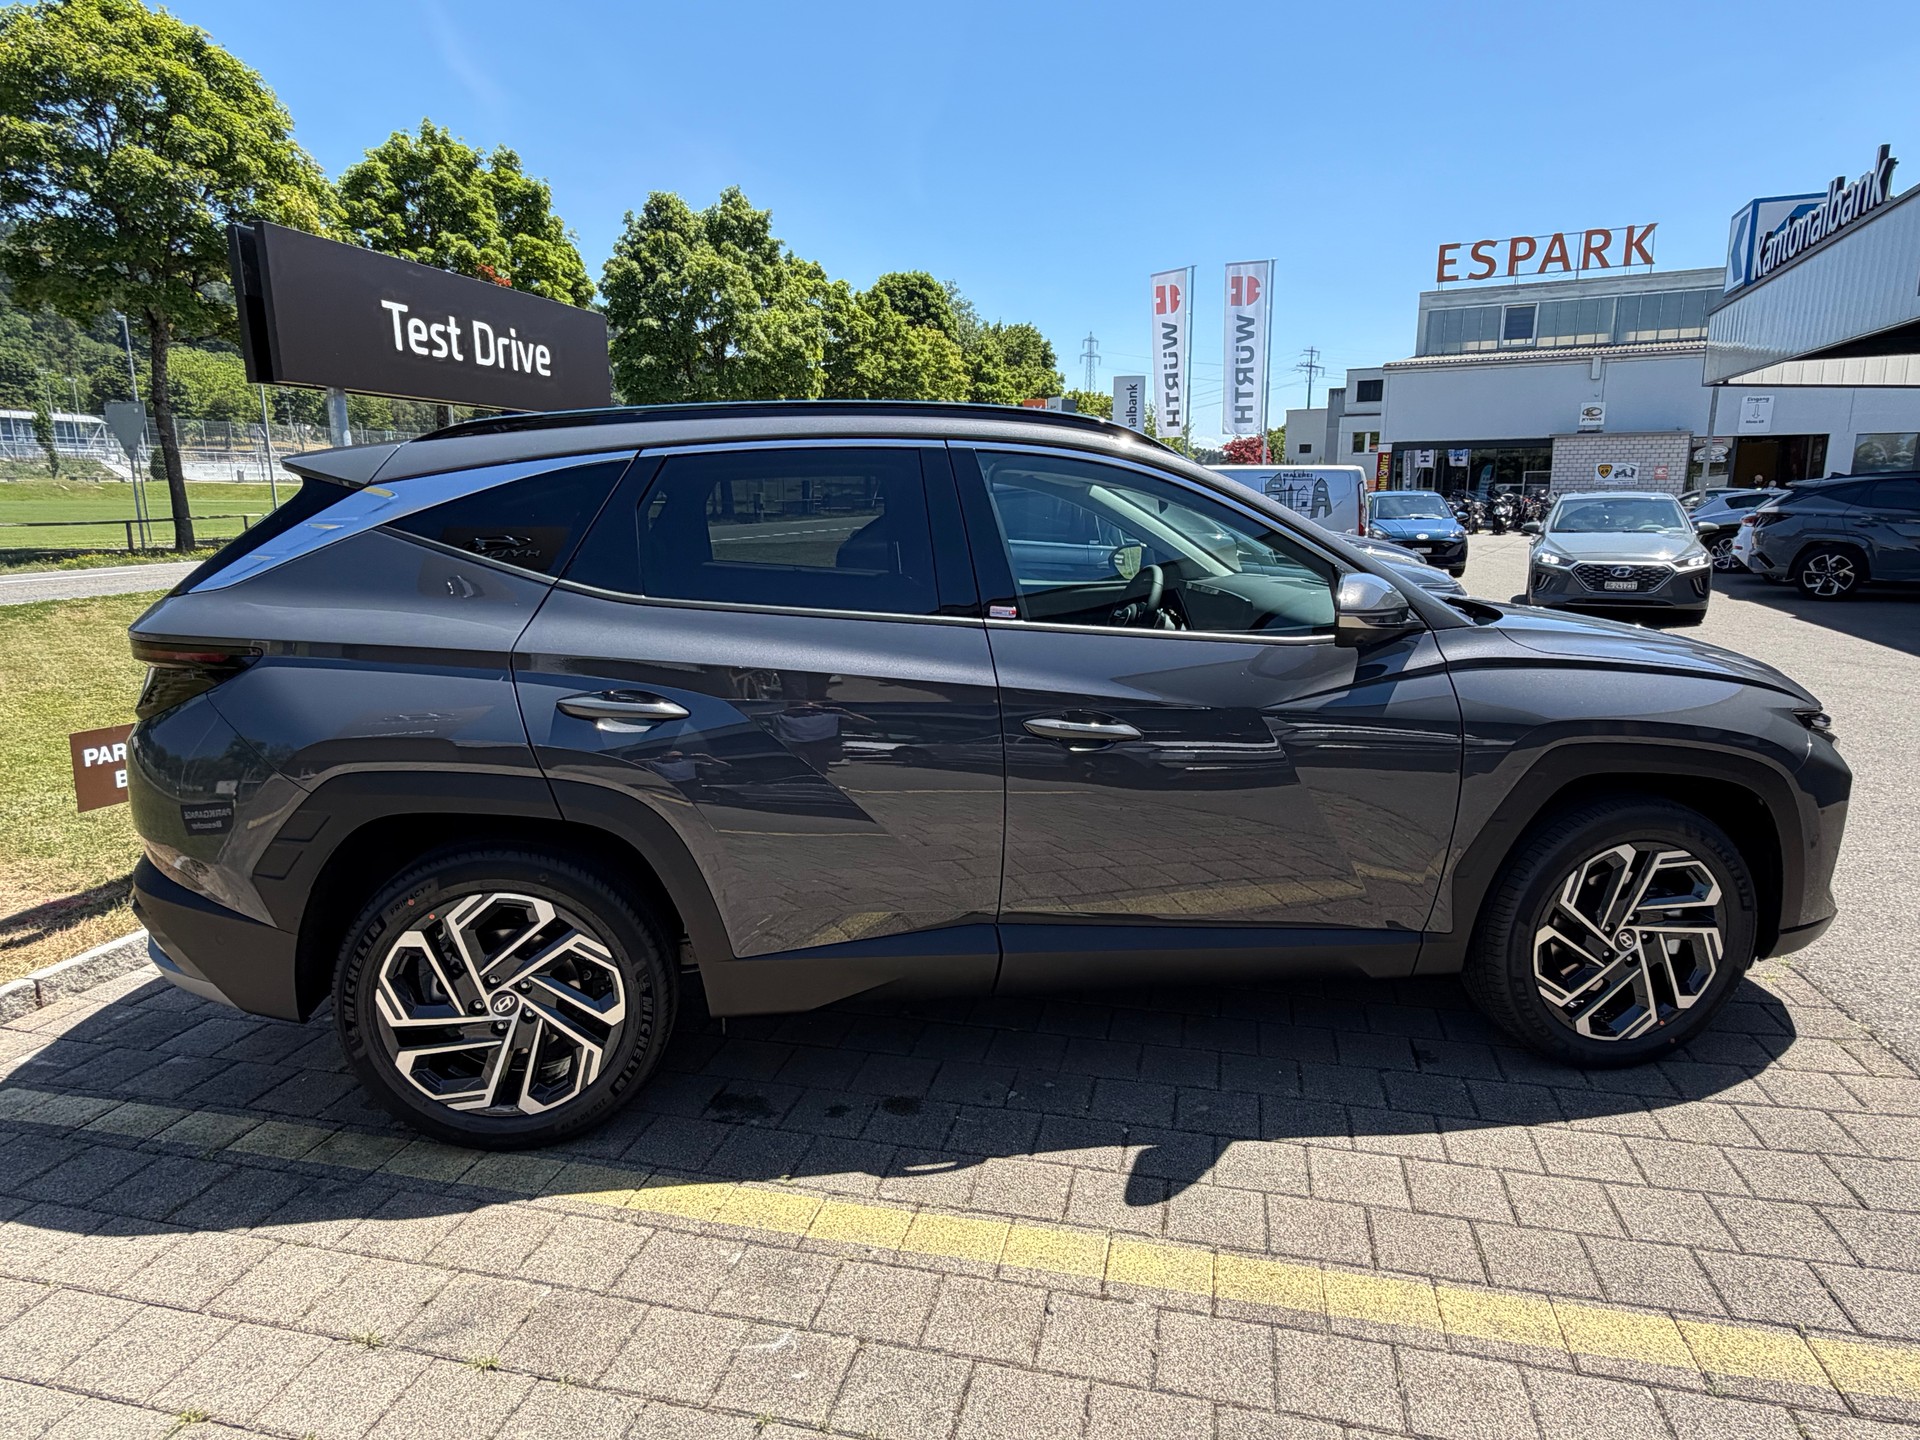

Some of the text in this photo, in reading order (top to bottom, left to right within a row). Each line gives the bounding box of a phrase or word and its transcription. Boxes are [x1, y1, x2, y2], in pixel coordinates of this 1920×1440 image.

[1437, 223, 1659, 282] ESPARK
[1751, 144, 1892, 281] Kantonalbank
[381, 299, 551, 377] Test Drive
[344, 919, 382, 1023] MICHELIN
[613, 996, 654, 1093] MICHELIN
